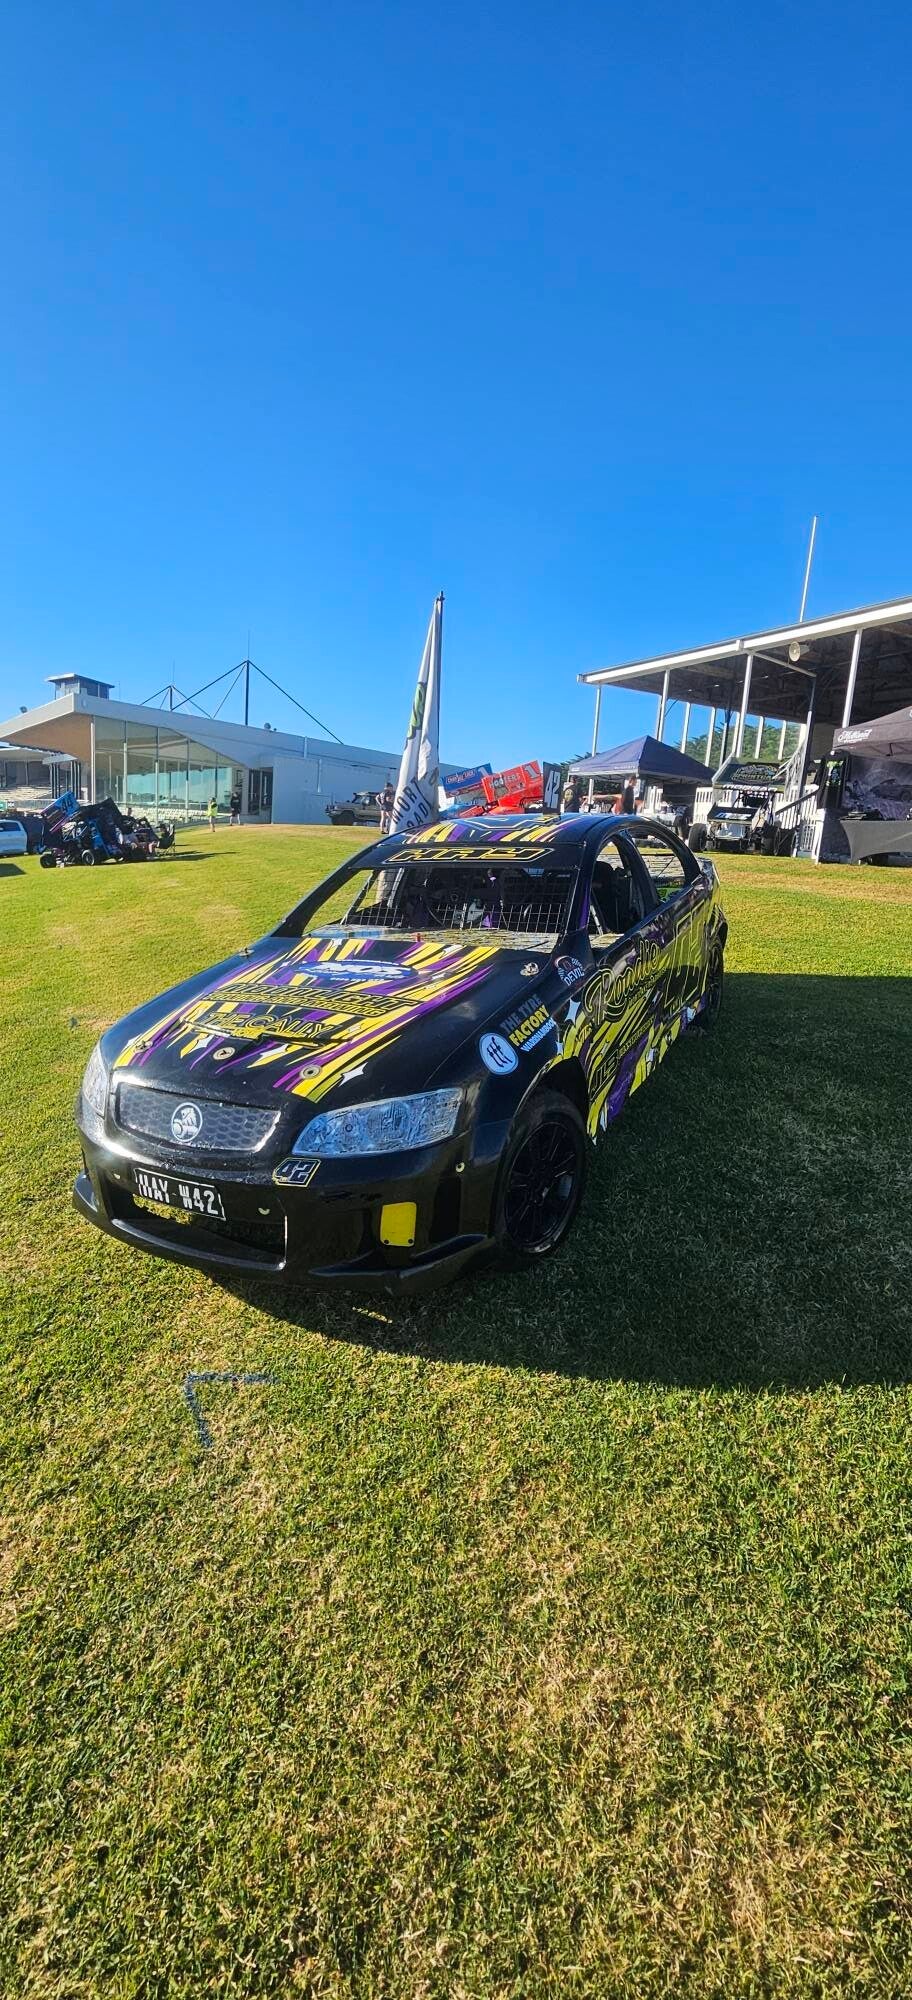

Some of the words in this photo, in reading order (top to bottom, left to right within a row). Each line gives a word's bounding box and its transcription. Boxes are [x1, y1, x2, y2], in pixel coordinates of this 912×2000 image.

[545, 771, 561, 809] 42
[245, 1014, 335, 1039] CALLY
[500, 1012, 520, 1033] THE
[508, 1004, 550, 1047] FACTORY
[275, 1159, 318, 1184] 42
[138, 1173, 170, 1204] HAY
[178, 1184, 219, 1216] W42
